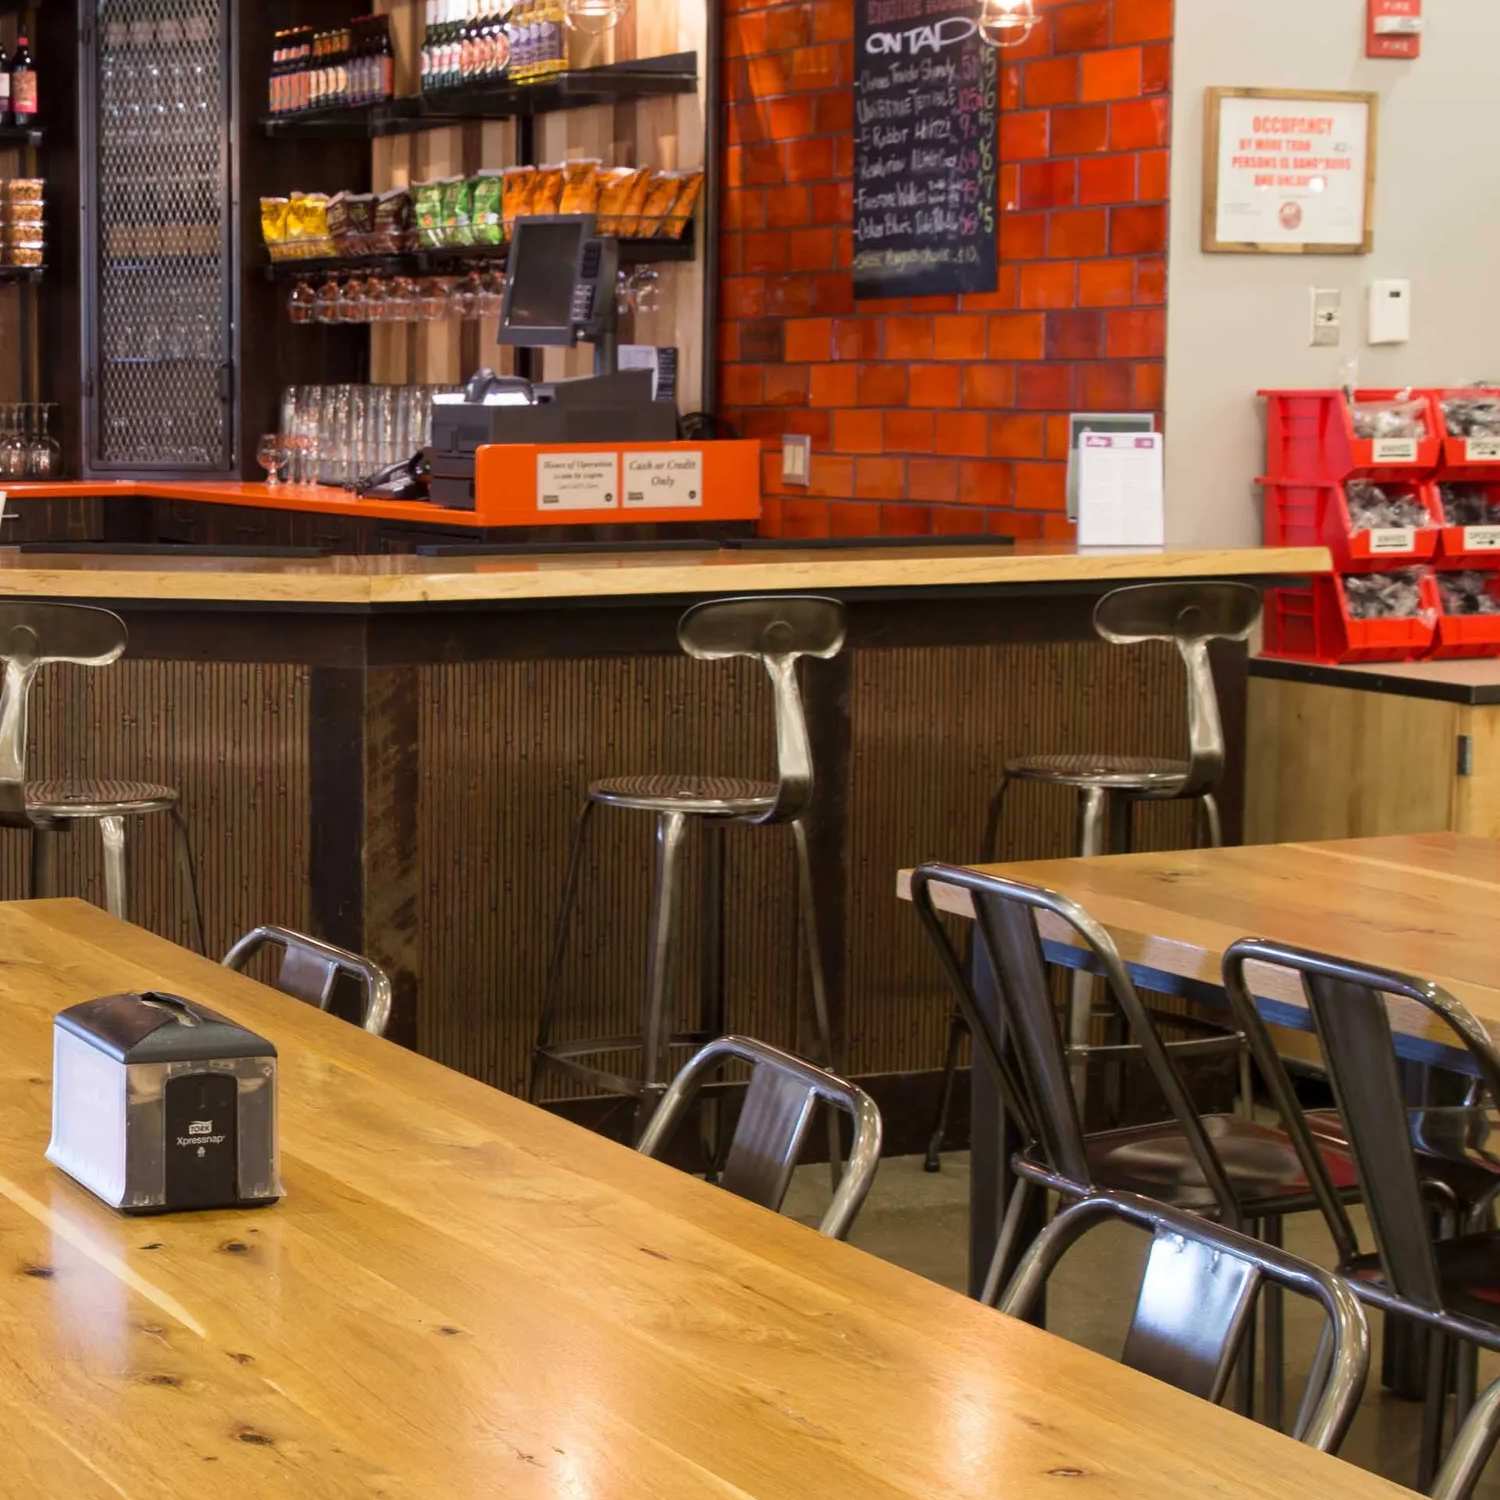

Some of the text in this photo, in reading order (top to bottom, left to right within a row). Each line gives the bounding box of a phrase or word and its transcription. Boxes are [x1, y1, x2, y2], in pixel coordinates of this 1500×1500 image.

[865, 16, 977, 55] ON TAP
[1253, 115, 1334, 135] OCCUPANCY
[1239, 138, 1252, 151] BY
[1254, 138, 1282, 152] MORE
[1286, 140, 1312, 152] THAN
[1232, 156, 1277, 169] PERSONS
[1280, 157, 1289, 169] IS
[629, 460, 652, 470] Cash
[666, 460, 696, 470] Credit
[651, 476, 675, 487] Only
[191, 1125, 210, 1133] TORK
[177, 1135, 224, 1147] Xpressnap
